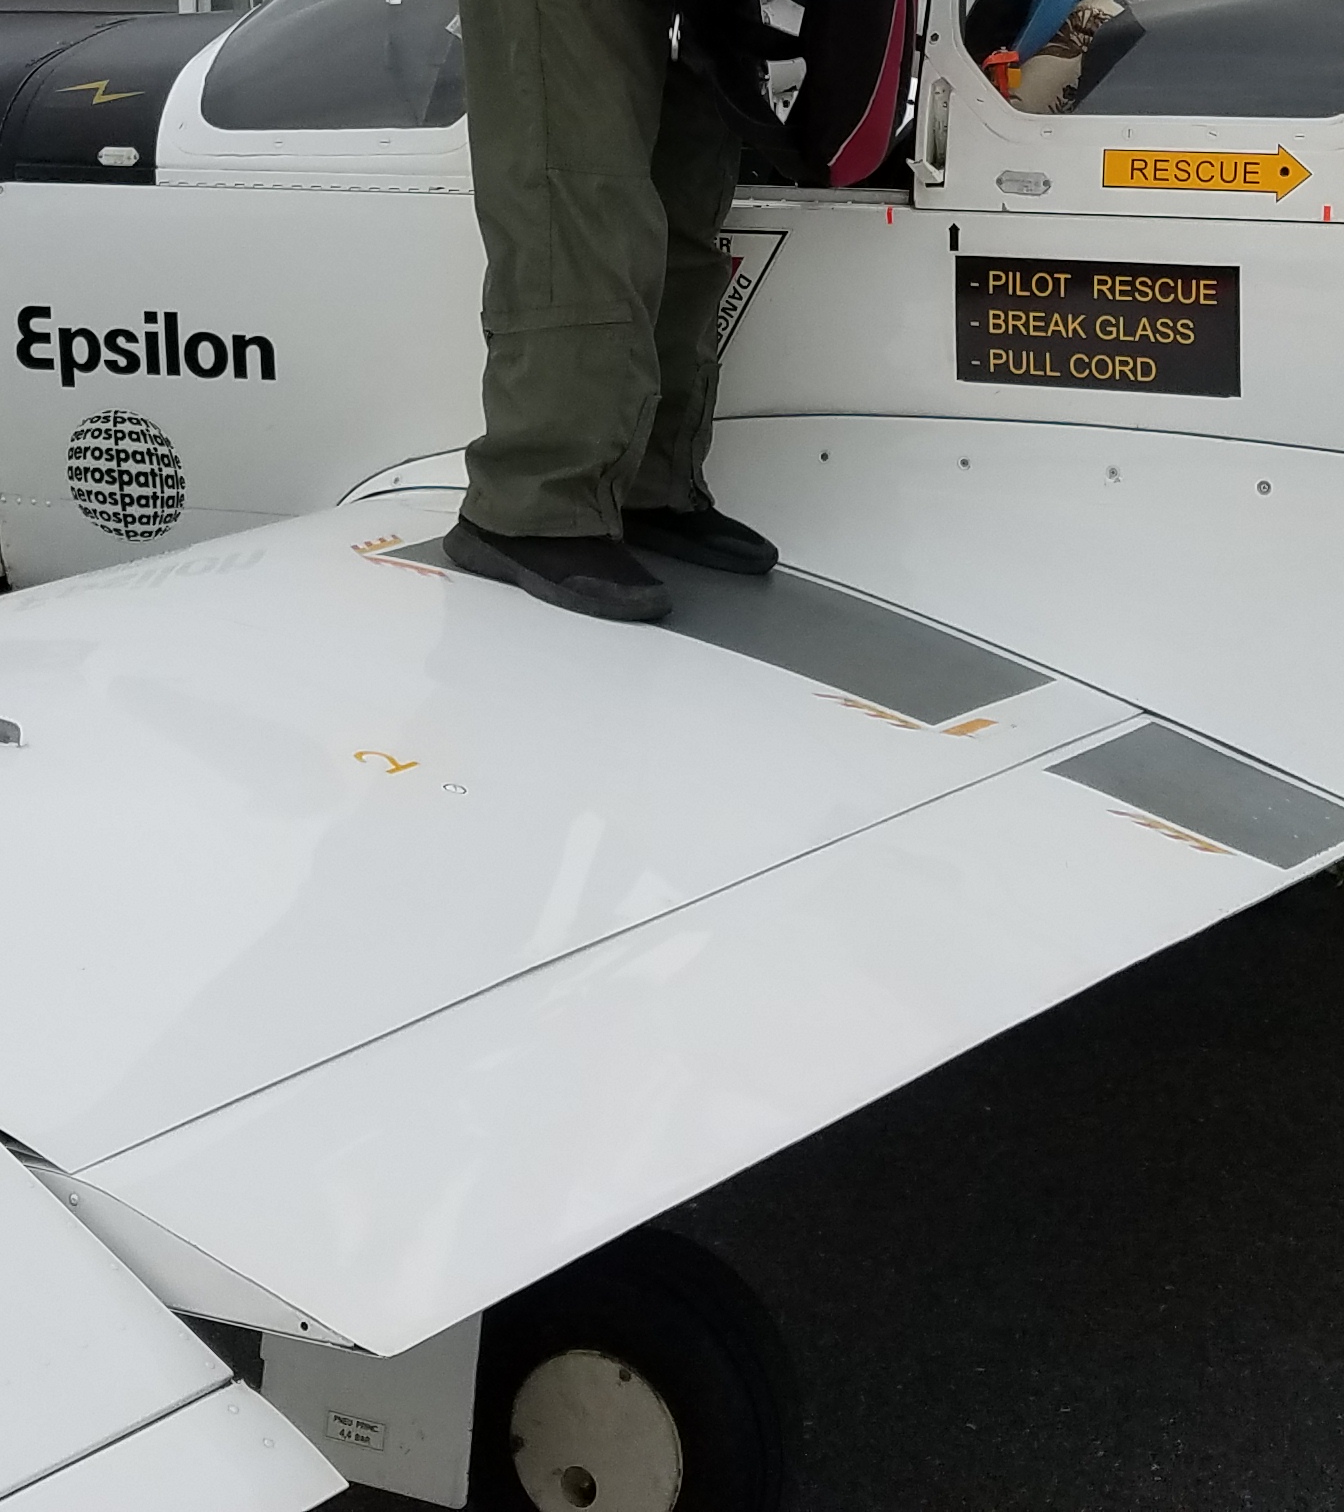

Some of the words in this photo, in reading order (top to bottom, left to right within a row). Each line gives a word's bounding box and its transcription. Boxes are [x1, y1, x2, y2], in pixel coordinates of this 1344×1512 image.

[1128, 157, 1263, 186] RESCUE
[988, 270, 1072, 298] PILOT
[1092, 274, 1219, 305] RESCUE
[988, 309, 1087, 340] BREAK
[1094, 315, 1196, 345] GLASS
[16, 305, 277, 388] Epsilon
[988, 349, 1061, 377] PULL
[1069, 352, 1158, 383] CORD
[67, 445, 182, 470] aerospatiale
[67, 465, 186, 494] aerospatiale
[70, 485, 186, 512] aerospatiale
